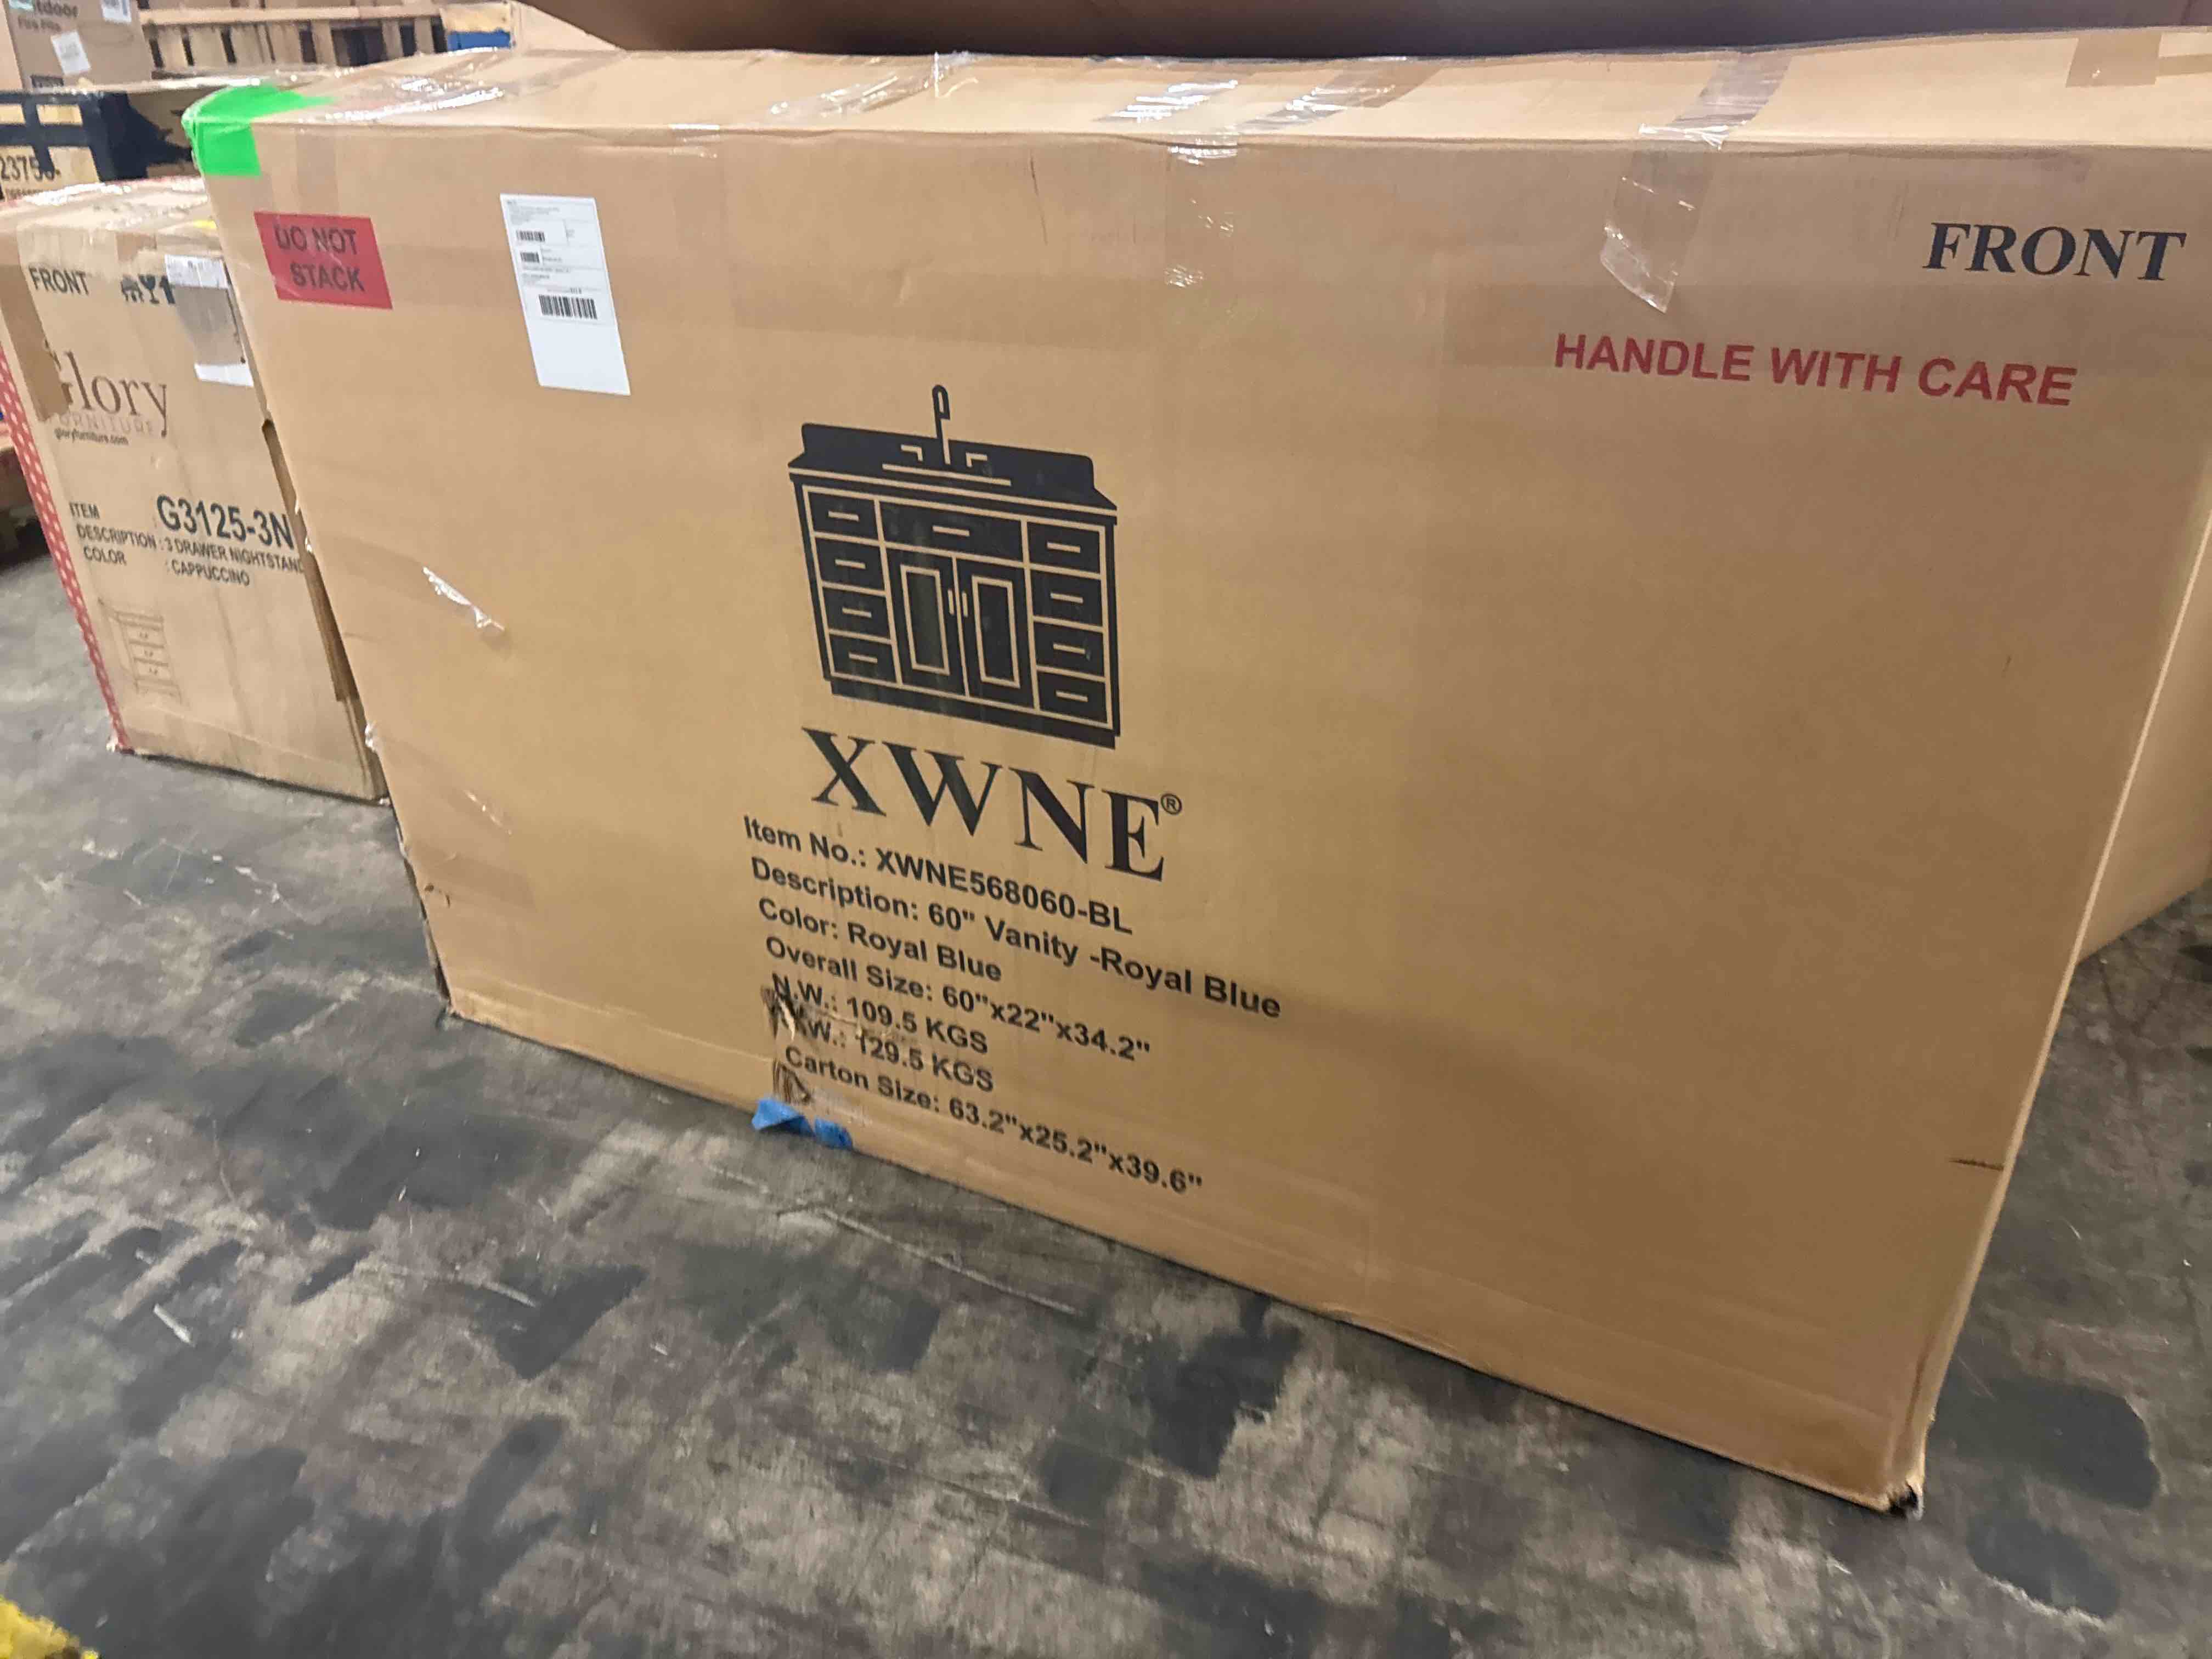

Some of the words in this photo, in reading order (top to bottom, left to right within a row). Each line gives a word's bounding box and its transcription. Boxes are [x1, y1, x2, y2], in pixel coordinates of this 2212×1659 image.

[274, 222, 307, 251] DO
[312, 226, 357, 255] NOT
[1922, 221, 2187, 281] FRONT
[28, 267, 89, 296] FRONT
[290, 261, 366, 292] STACK
[45, 340, 167, 438] lory
[1554, 332, 1755, 382] HANDLE
[1770, 347, 1903, 394] WITH
[1917, 357, 2079, 407] CARE
[69, 501, 100, 519] ITEM
[156, 494, 295, 550] G3125-3N
[76, 524, 156, 549] DESCRIPTION
[164, 537, 173, 552] 3
[174, 538, 227, 559] DRAWER
[83, 545, 127, 565] COLOR
[171, 559, 250, 586] CAPPUCCINO
[743, 815, 802, 853] Item
[809, 832, 866, 868] No.:
[876, 846, 1133, 935] XWNE568060-BL
[751, 856, 919, 921] Description:
[929, 902, 975, 931] 60"
[985, 915, 1079, 967] Vanity
[1090, 945, 1192, 994] -Royal
[1204, 974, 1282, 1019] Blue
[759, 897, 838, 939] Color:
[847, 921, 928, 962] Royal
[937, 944, 1002, 982] Blue
[766, 935, 857, 982] Overall
[866, 964, 933, 1002] Size:
[943, 985, 1150, 1061] 60"x22"x34.2"
[771, 972, 838, 1012] N.W.:
[847, 996, 917, 1034] 109.5
[926, 1016, 989, 1054] KGS
[855, 1031, 924, 1071] 129.5
[932, 1053, 995, 1093] KGS
[785, 1045, 870, 1091] Carton
[949, 1097, 1203, 1194] 63.2"x25.2"x39.6"
